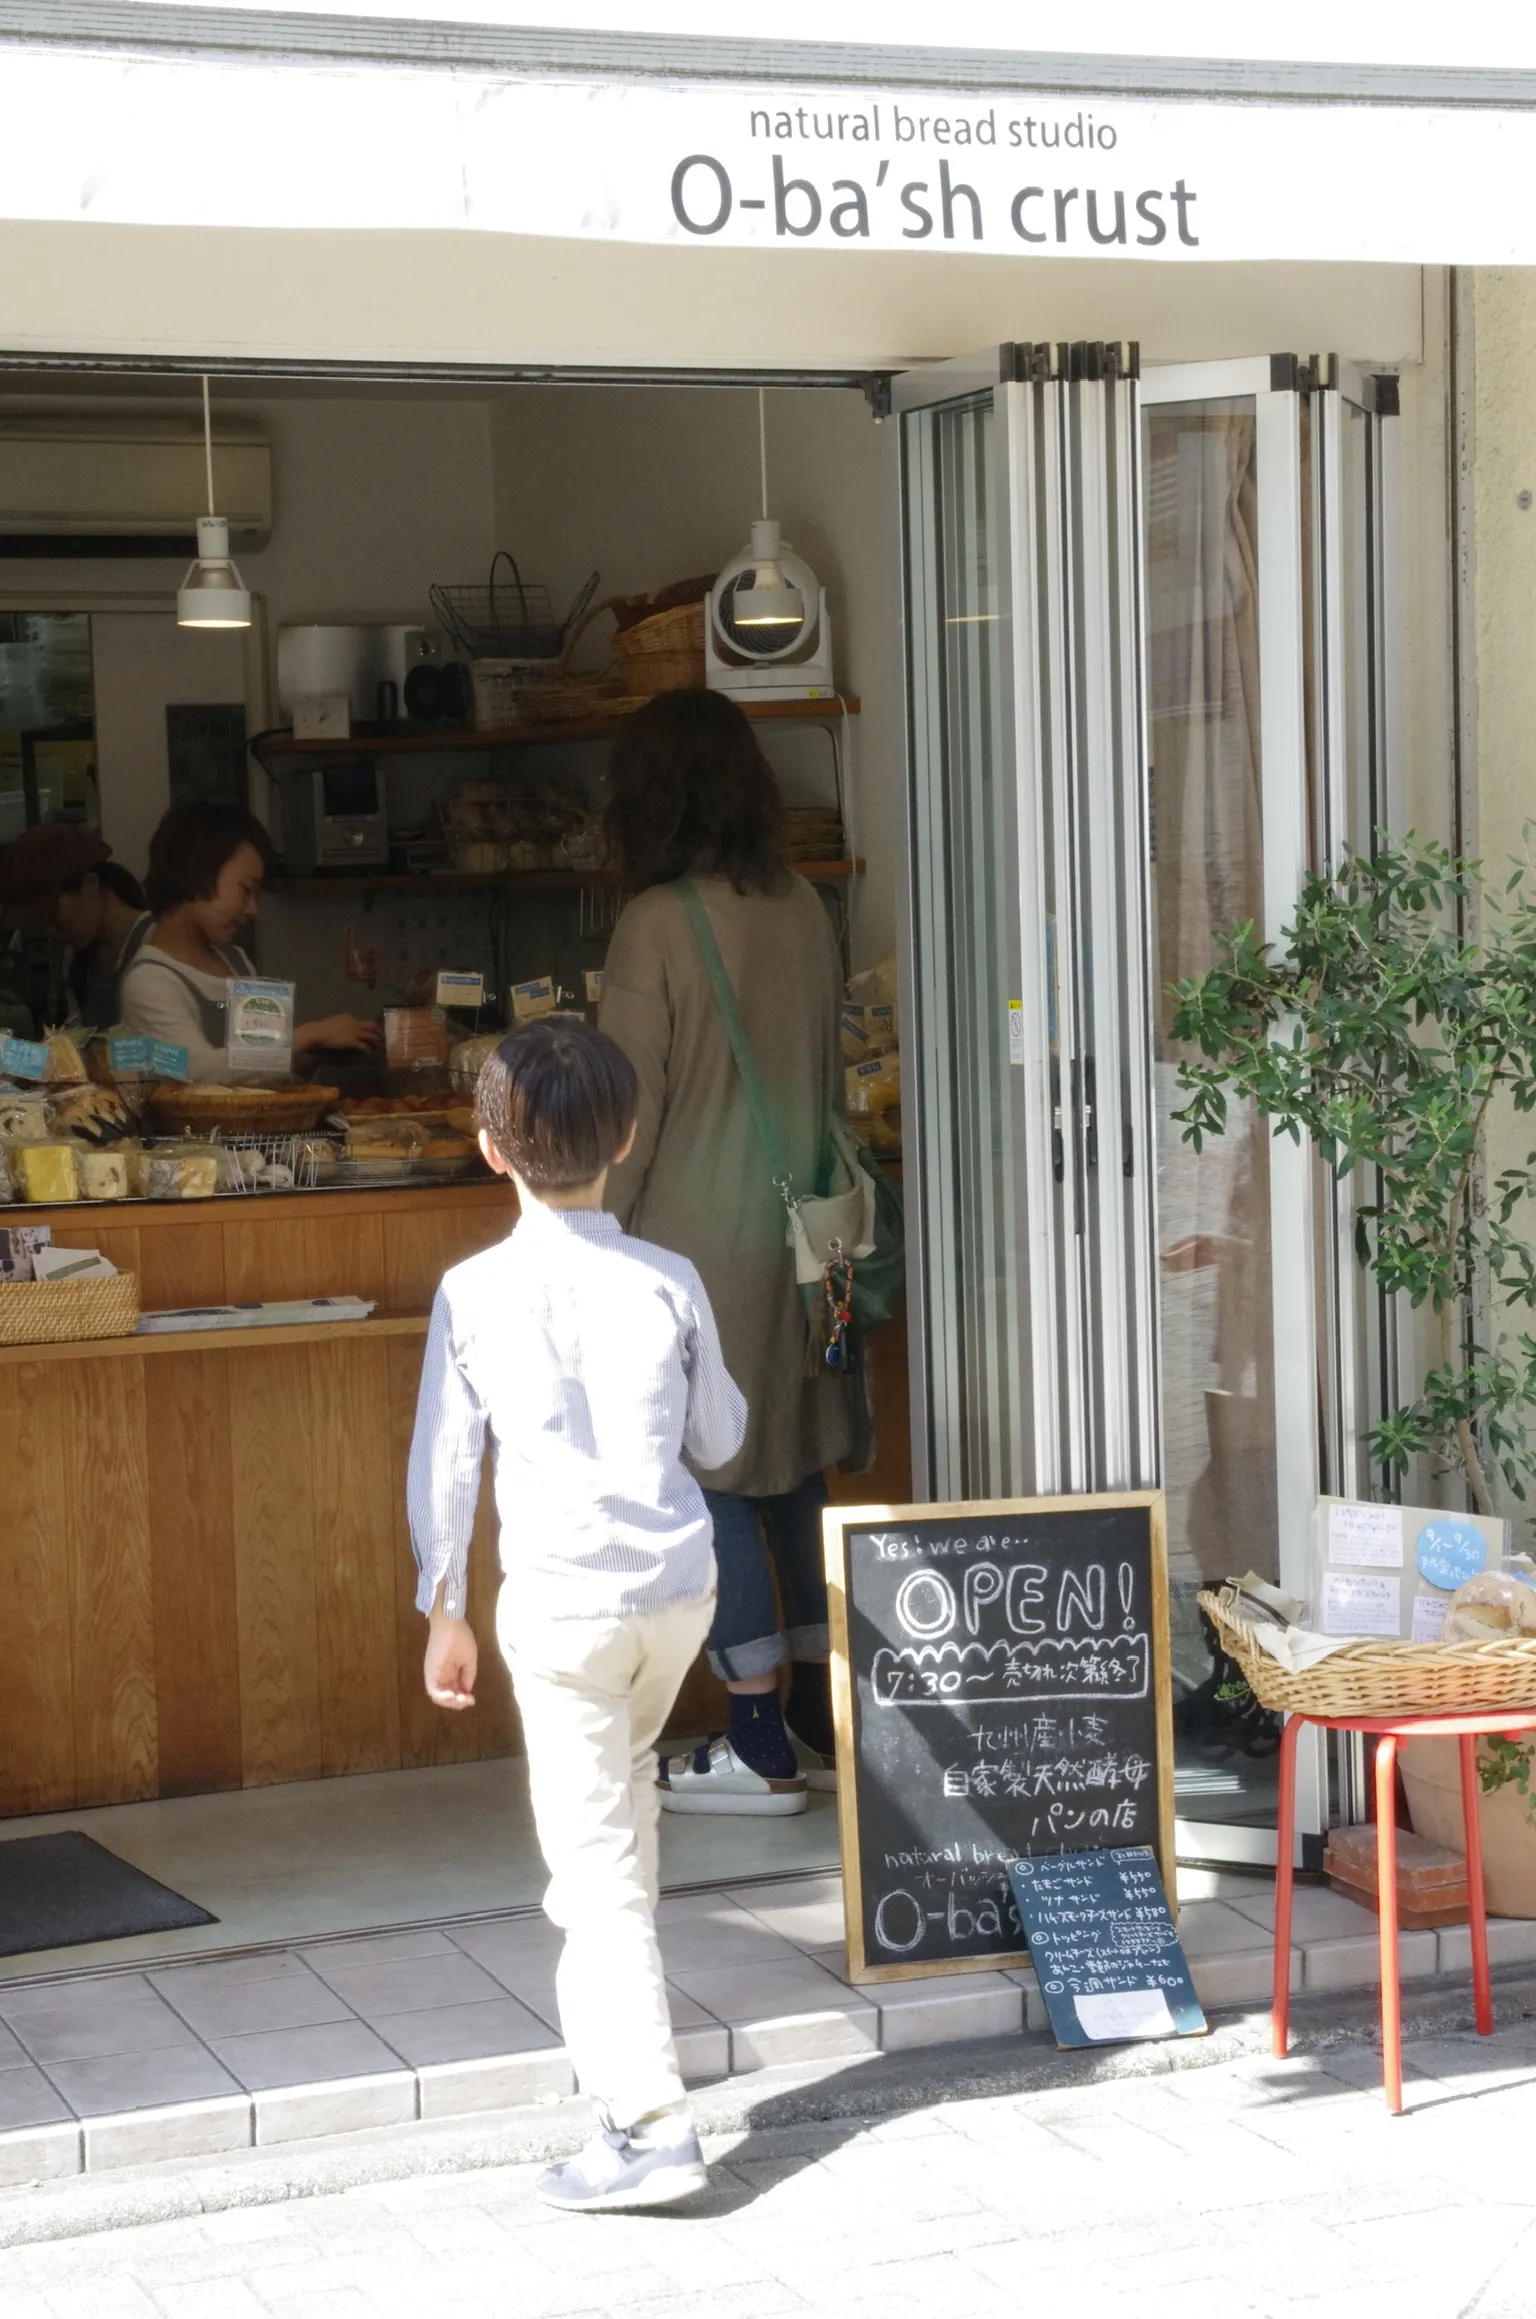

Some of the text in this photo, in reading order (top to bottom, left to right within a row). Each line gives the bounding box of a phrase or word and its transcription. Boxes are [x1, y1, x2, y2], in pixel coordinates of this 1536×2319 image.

[750, 104, 1117, 150] natural bread studio
[1010, 178, 1200, 247] crust
[929, 1536, 968, 1556] we
[895, 1561, 1136, 1641] OPEN!
[967, 1711, 1108, 1752] 九州産小麦
[943, 1751, 1152, 1798] 自家製天然酵母
[1030, 1798, 1138, 1837] パンの店
[884, 1841, 962, 1868] natural
[1040, 1855, 1106, 1873] ベーグルサンド
[1053, 1930, 1102, 1946] トッピング
